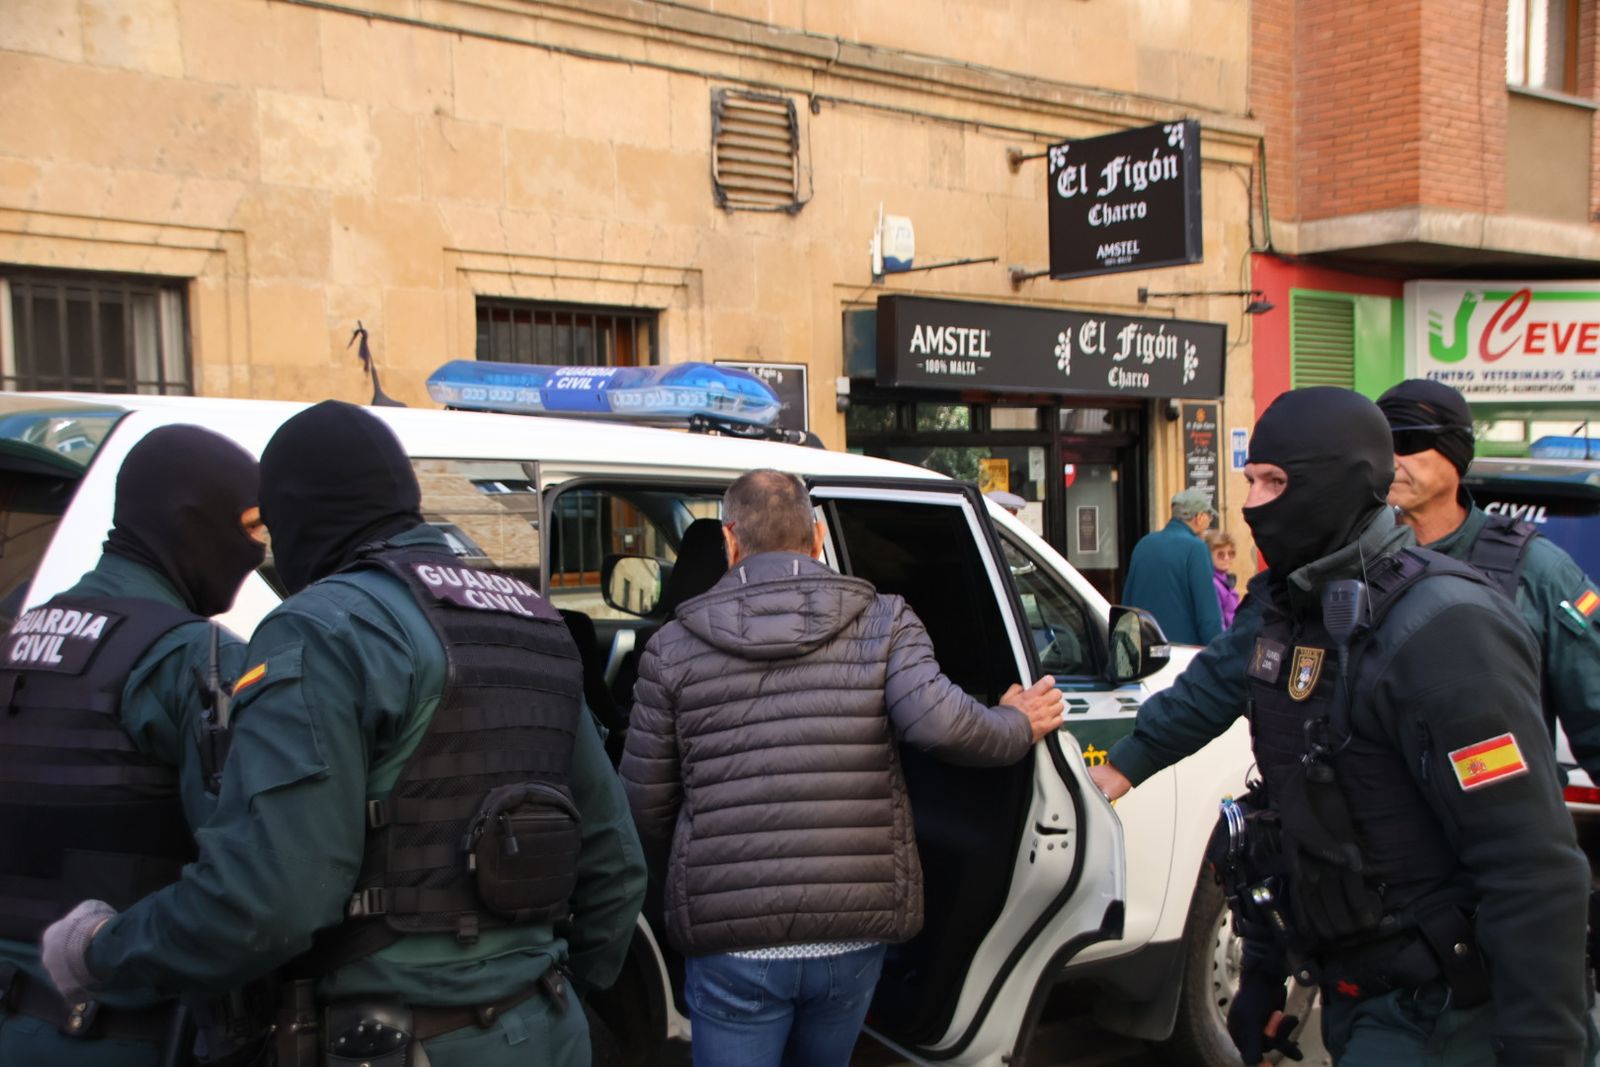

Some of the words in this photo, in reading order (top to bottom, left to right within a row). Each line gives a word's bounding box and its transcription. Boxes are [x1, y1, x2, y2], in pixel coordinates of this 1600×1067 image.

[1057, 163, 1088, 198] El
[1097, 148, 1178, 197] Figón
[1088, 201, 1147, 227] Charro
[1096, 240, 1140, 260] AMSTEL
[909, 323, 991, 358] AMSTEL
[1079, 320, 1106, 355] El
[1112, 323, 1178, 365] Figón
[949, 360, 976, 376] MALTA
[1108, 366, 1150, 389] Charro
[1482, 369, 1564, 382] VETERINARIO
[556, 377, 593, 390] CIVIL
[1484, 502, 1548, 523] CIVIL
[417, 564, 541, 599] GUARDIA
[465, 589, 534, 617] CIVIL
[10, 608, 109, 640] GUARDIA
[11, 634, 65, 664] CIVIL
